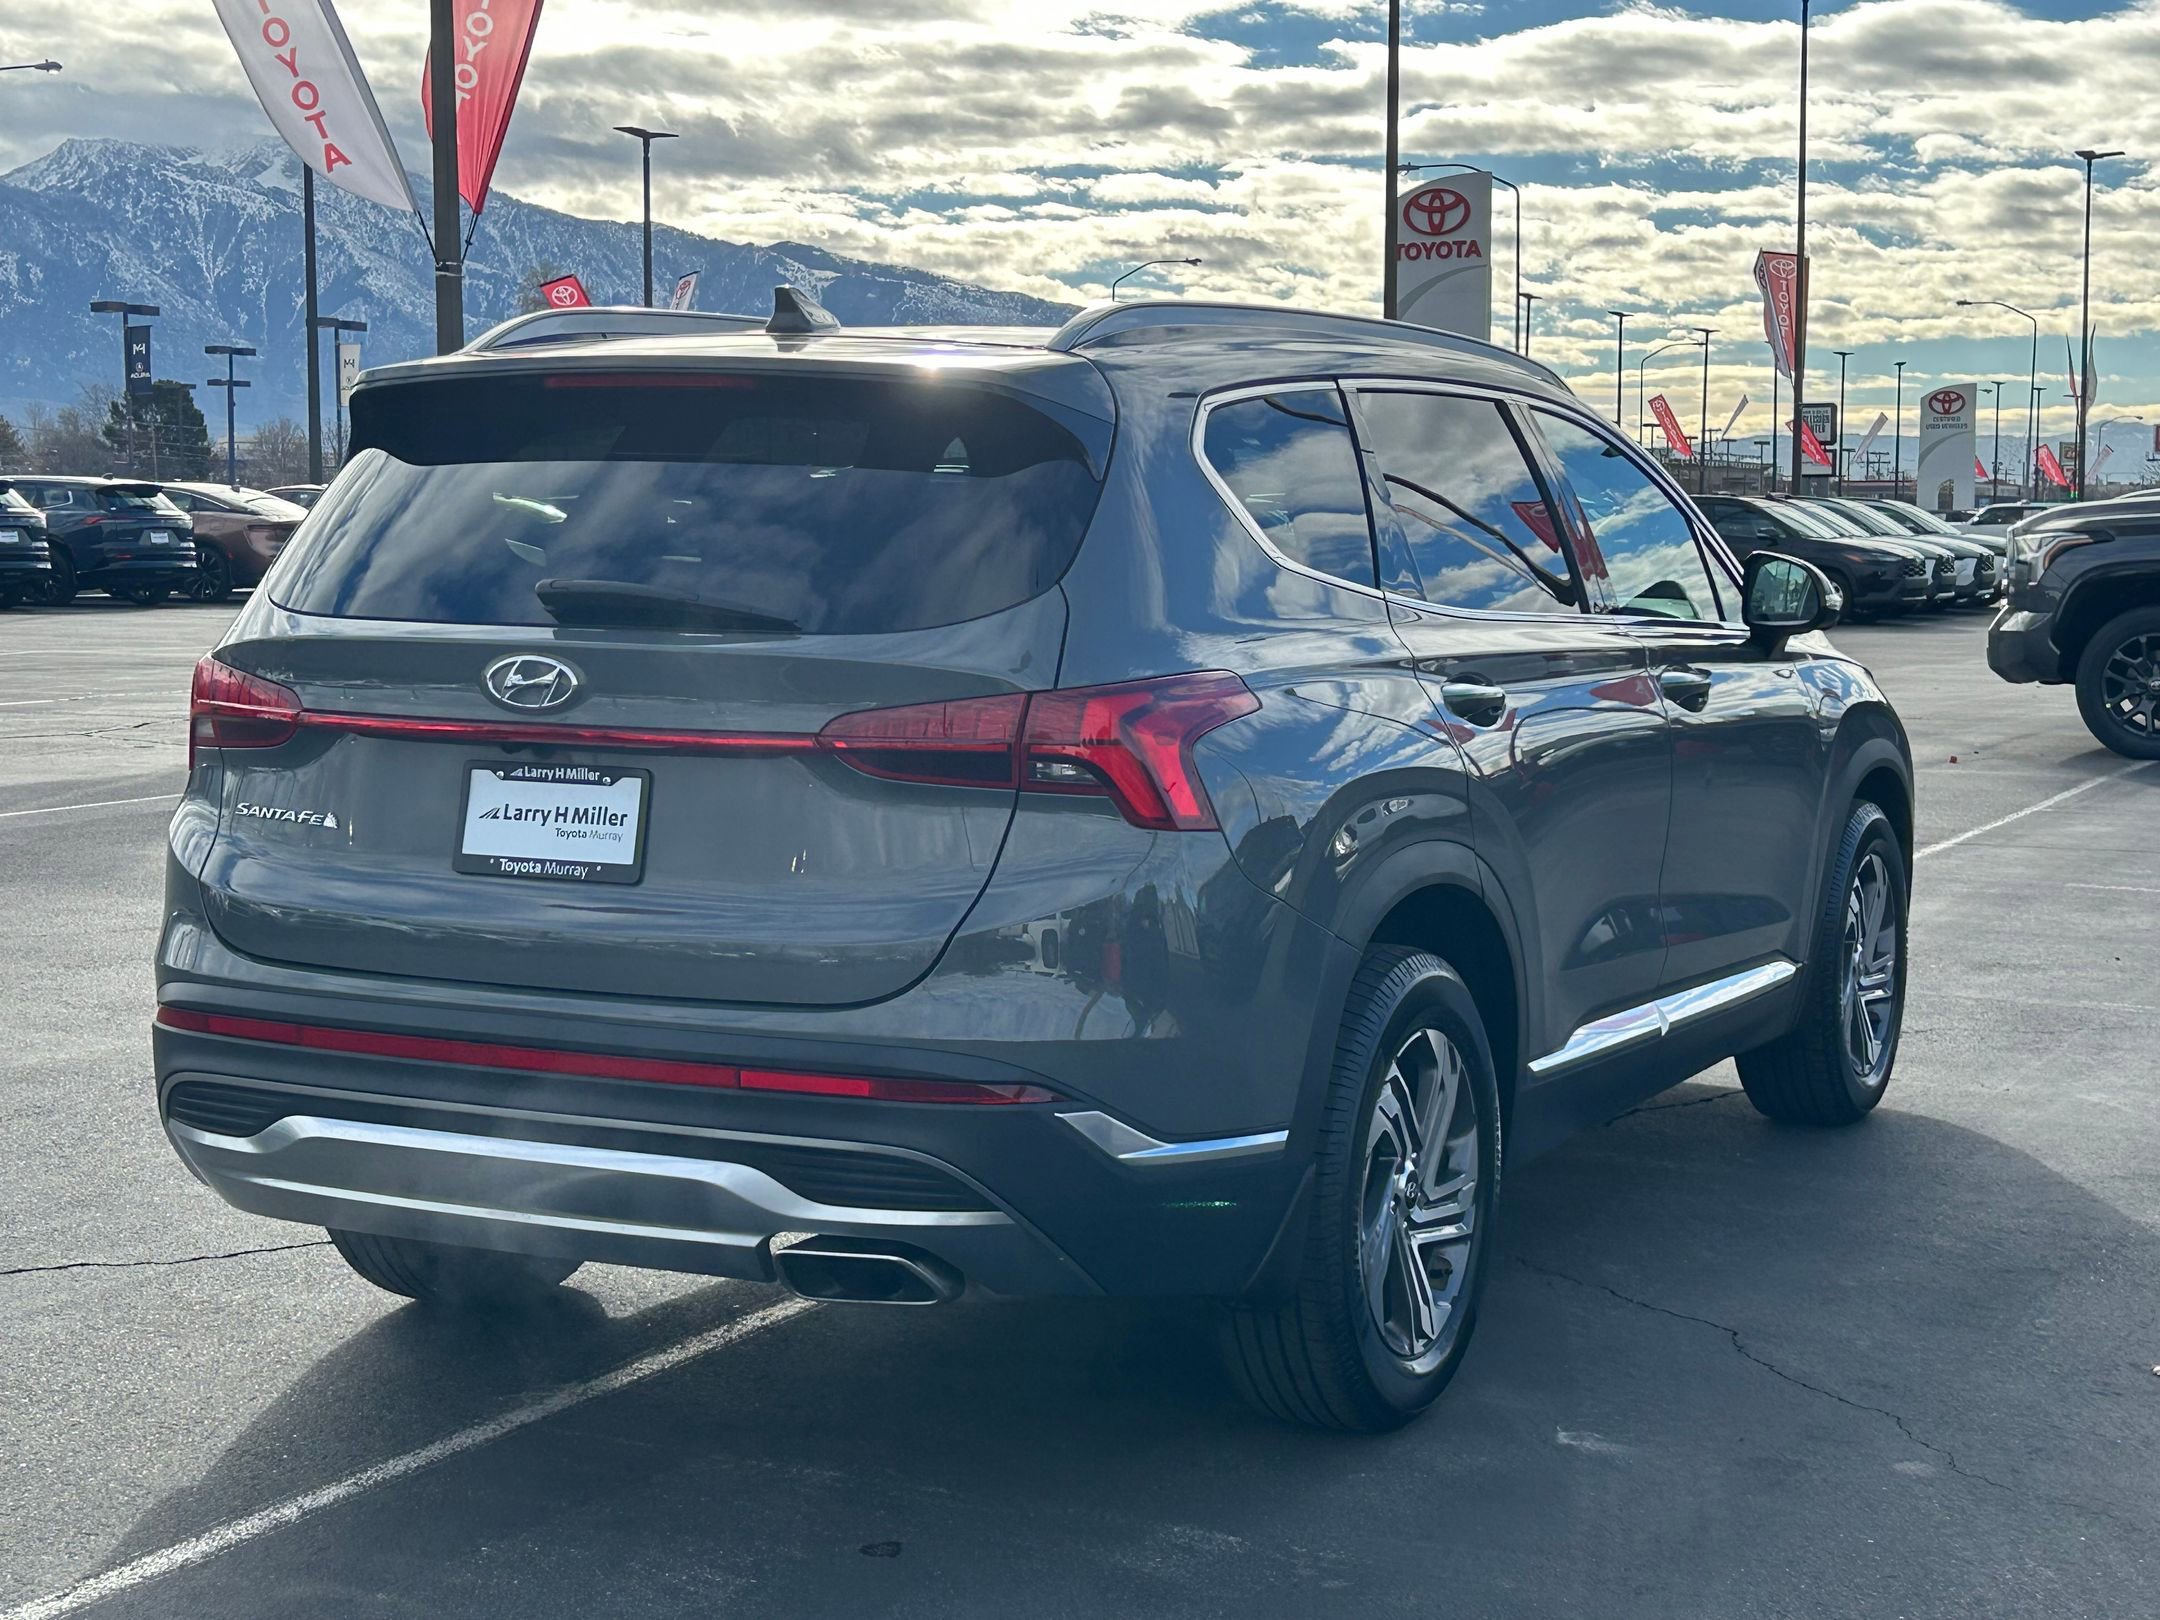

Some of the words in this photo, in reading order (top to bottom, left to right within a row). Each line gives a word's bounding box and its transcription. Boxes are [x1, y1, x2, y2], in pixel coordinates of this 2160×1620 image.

[1395, 240, 1482, 261] TOYOTA
[524, 766, 553, 781] Larry
[555, 768, 564, 779] H
[565, 767, 600, 781] Miller
[503, 803, 552, 827] Larry
[554, 806, 569, 824] H
[571, 806, 628, 827] Miller
[555, 827, 587, 841] Toyota
[588, 828, 624, 844] Murray
[499, 858, 542, 875] Toyota
[543, 859, 589, 880] Murray
